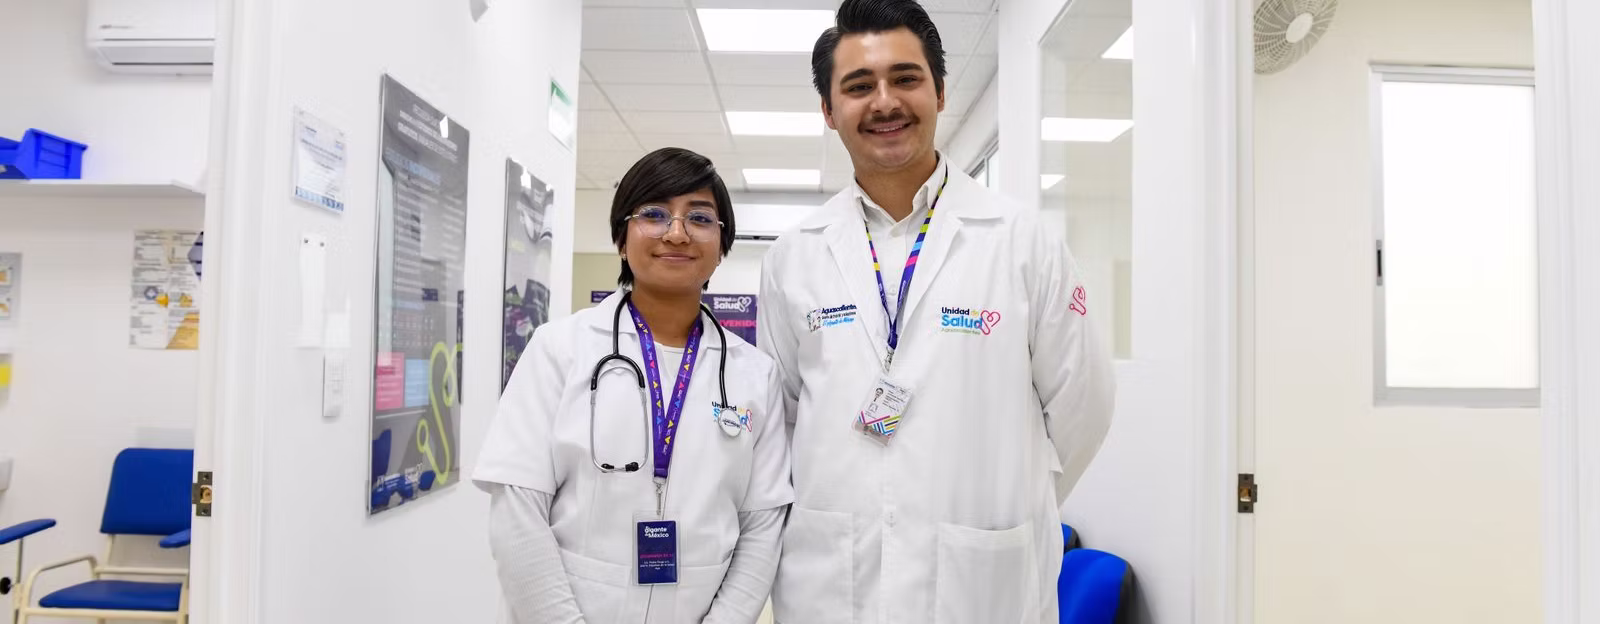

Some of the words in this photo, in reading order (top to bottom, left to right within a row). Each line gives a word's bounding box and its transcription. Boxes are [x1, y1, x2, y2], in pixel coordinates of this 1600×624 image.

[714, 301, 740, 310] Salud
[941, 307, 970, 316] Unidad
[941, 315, 983, 329] Salud
